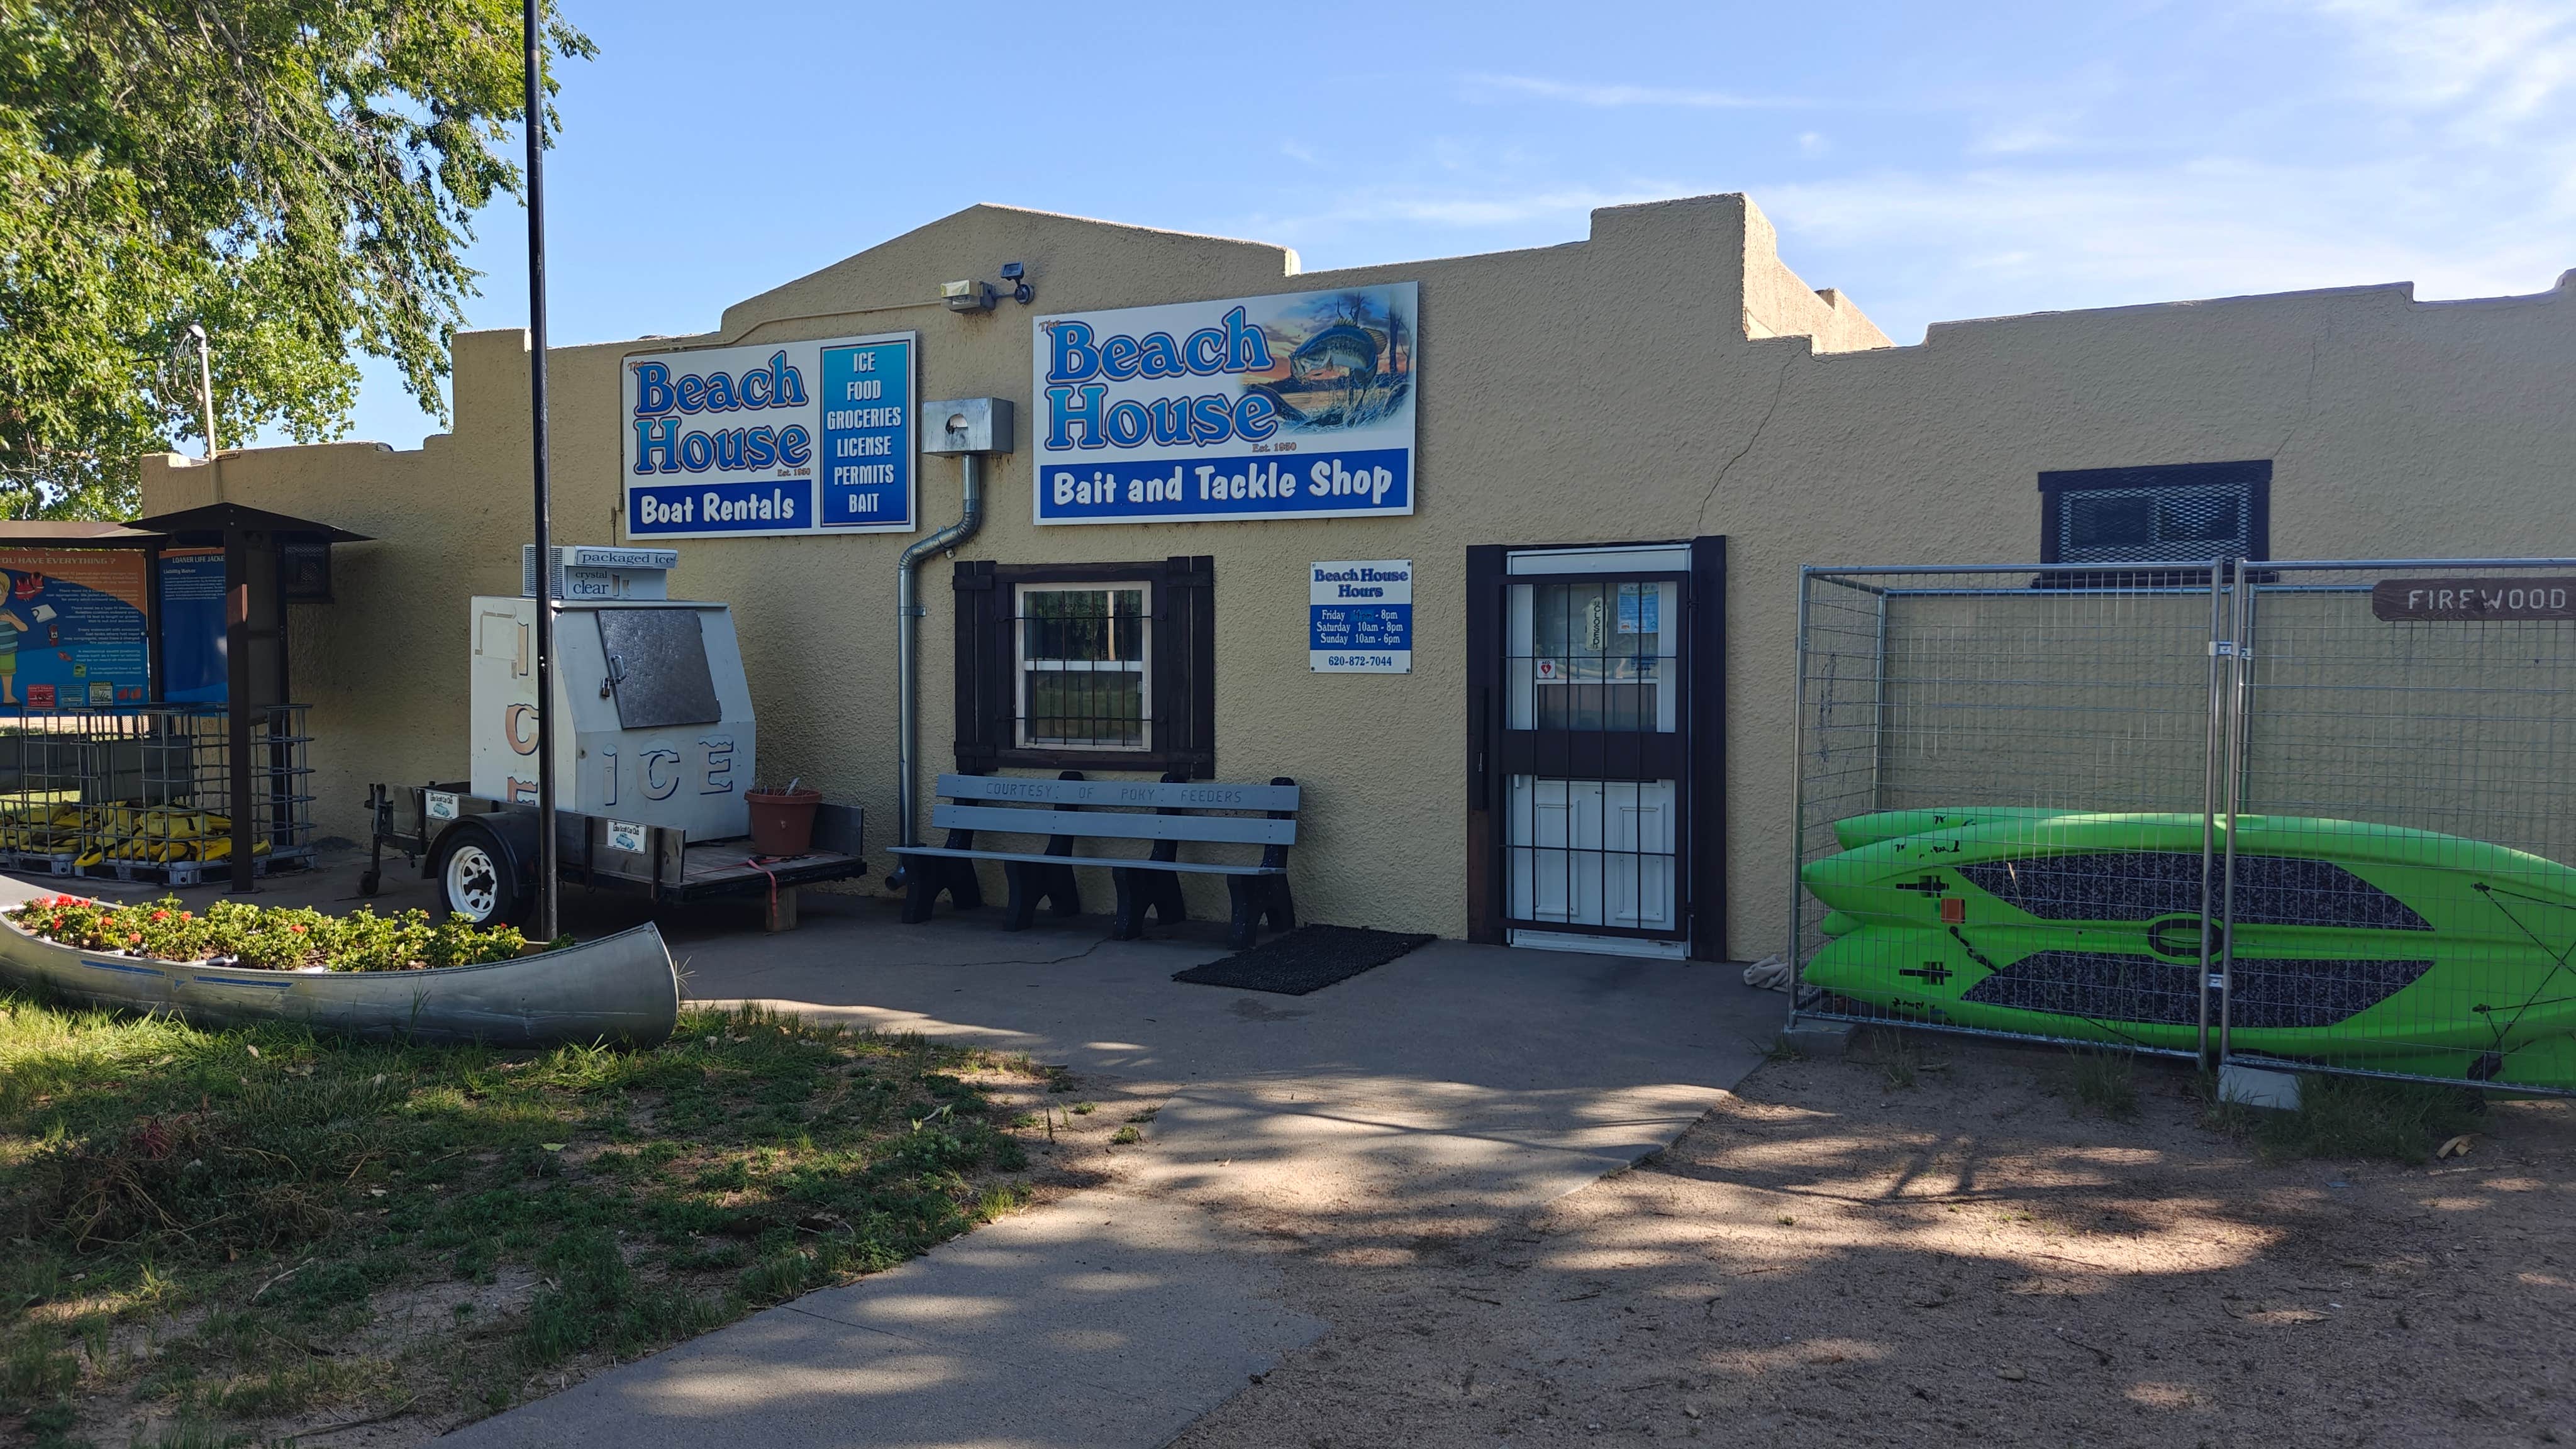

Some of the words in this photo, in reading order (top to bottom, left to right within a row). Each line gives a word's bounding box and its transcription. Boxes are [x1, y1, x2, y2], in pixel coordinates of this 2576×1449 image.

[1045, 305, 1275, 384] Beach
[853, 352, 876, 373] ICE
[634, 350, 809, 417] Beach
[847, 379, 882, 402] FOOD
[827, 406, 902, 430] GROCERIES
[1044, 383, 1279, 451] House
[633, 416, 811, 475] House
[836, 435, 892, 458] LICENSE
[1252, 442, 1271, 453] Est.
[834, 464, 895, 486] PERMITS
[1053, 472, 1116, 506] Bait
[1128, 466, 1183, 503] and
[1196, 461, 1297, 501] Tackle
[1309, 458, 1393, 505] Shop
[641, 494, 693, 525] Boat
[702, 488, 795, 523] Rentals
[848, 492, 880, 514] BAIT
[582, 552, 650, 565] packaged
[655, 554, 674, 564] ice
[575, 570, 608, 579] crystal
[1314, 568, 1359, 582] Beach
[1360, 568, 1409, 582] House
[573, 580, 609, 594] clear
[1338, 584, 1384, 598] Hours
[2408, 588, 2566, 610] FIREWOOD
[1321, 609, 1345, 621] Friday
[1381, 609, 1398, 621] 8pm
[1593, 604, 1601, 645] CLOSED
[1316, 621, 1351, 633] Saturday
[1358, 622, 1379, 631] 10am
[1386, 621, 1403, 634] 8pm
[1320, 633, 1348, 645] Sunday
[1355, 634, 1376, 643] 10am
[1384, 633, 1401, 646] 6pm
[1328, 656, 1392, 666] 620-872-7044
[602, 733, 734, 807] ICE
[986, 782, 1053, 797] COURTESY
[1079, 787, 1094, 799] OF
[1121, 788, 1156, 801] POKY
[1180, 789, 1243, 803] FEEDERS
